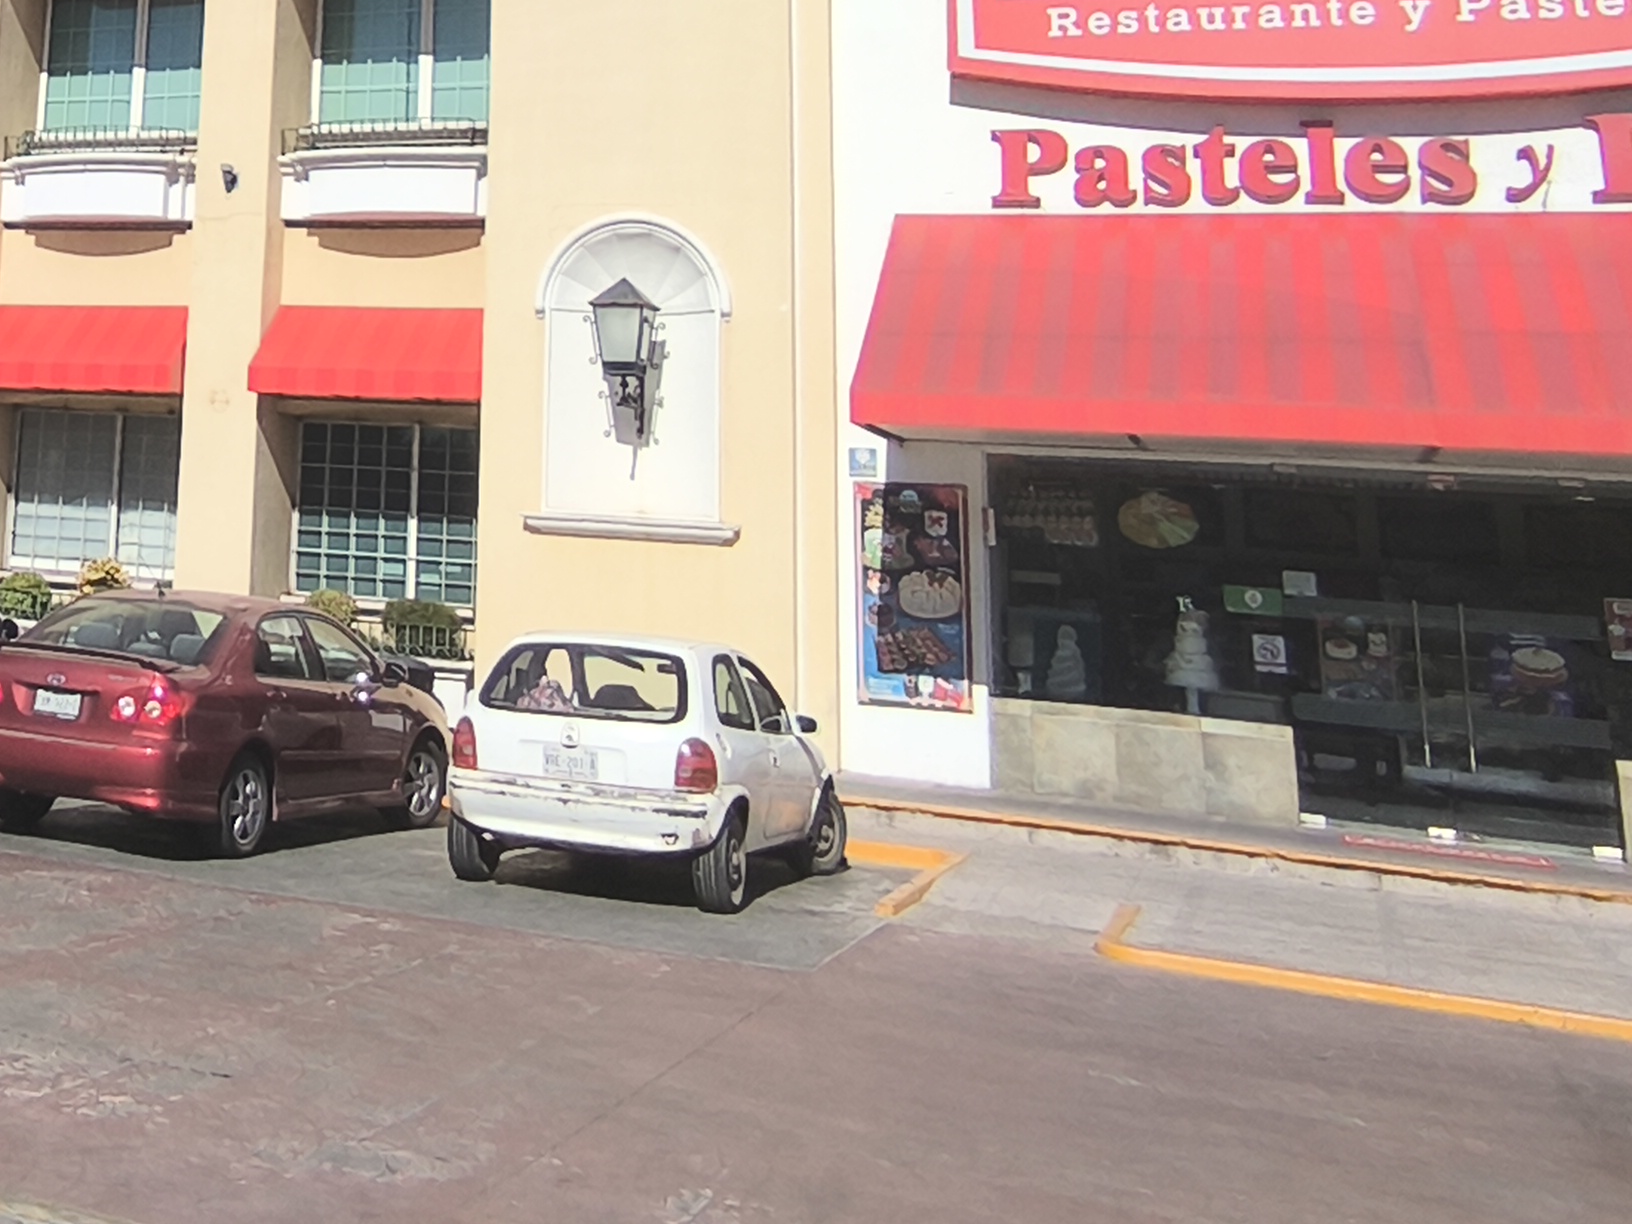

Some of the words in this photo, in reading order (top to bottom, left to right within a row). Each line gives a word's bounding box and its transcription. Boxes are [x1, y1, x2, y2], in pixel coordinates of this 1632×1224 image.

[1399, 0, 1431, 32] y
[990, 119, 1478, 209] Pasteles
[1505, 143, 1555, 204] y
